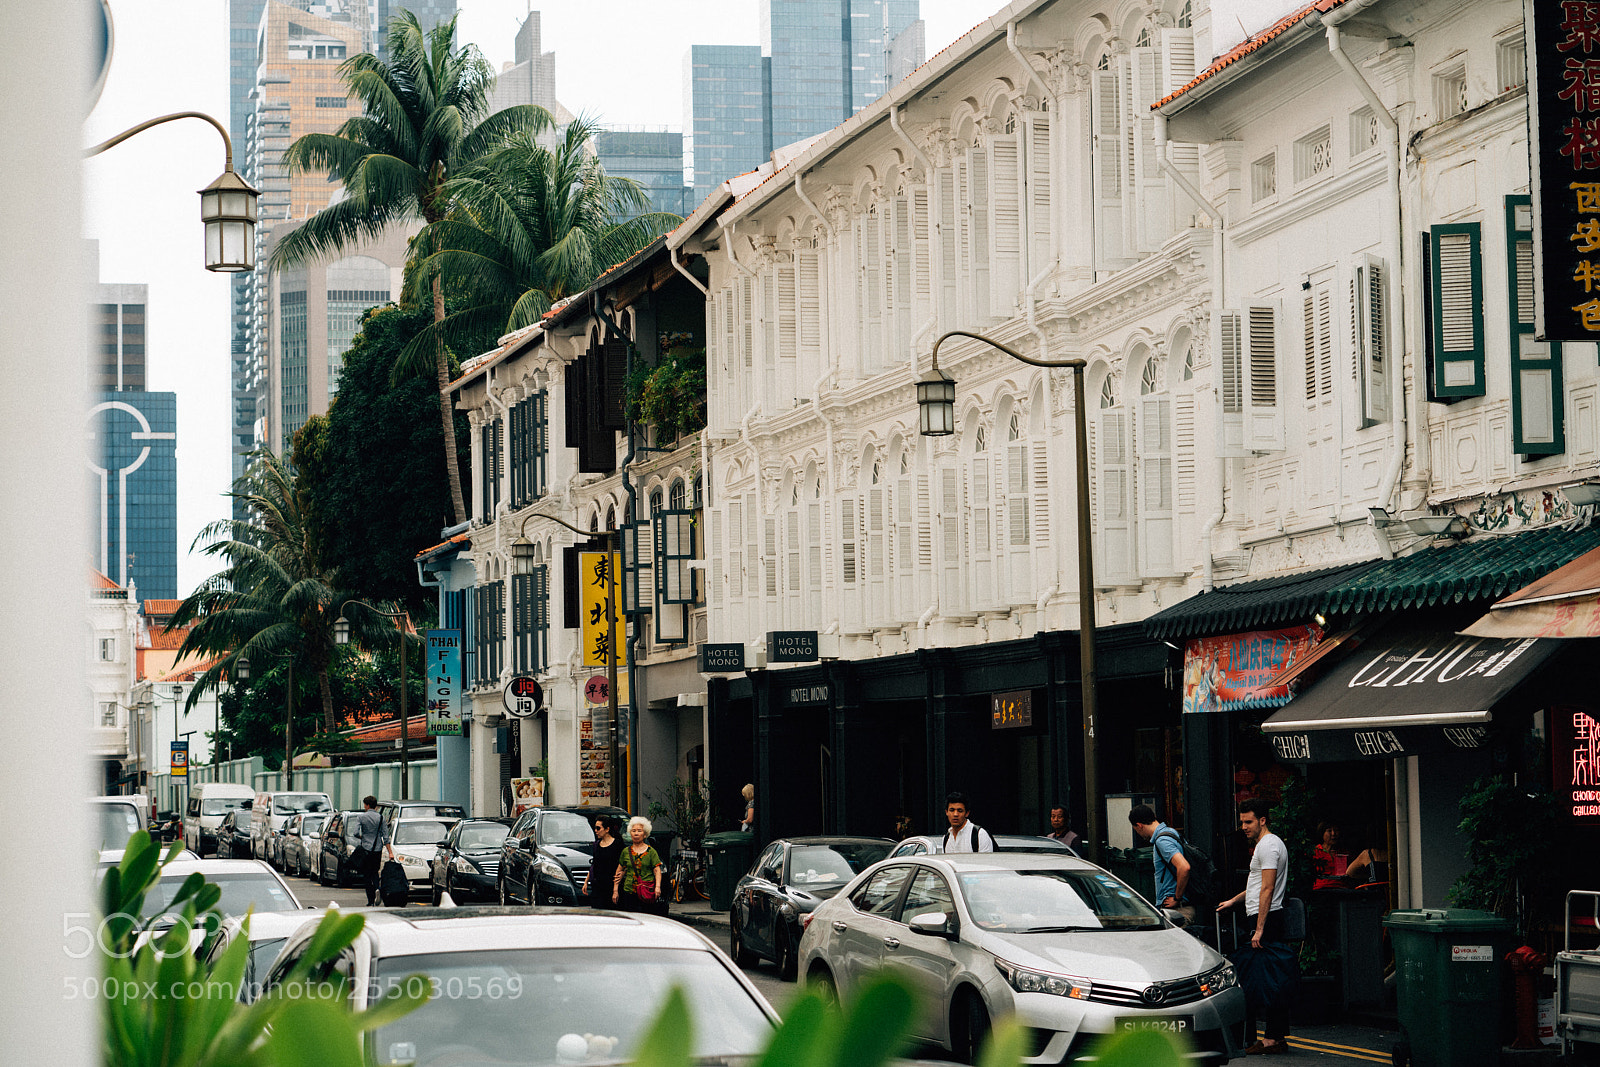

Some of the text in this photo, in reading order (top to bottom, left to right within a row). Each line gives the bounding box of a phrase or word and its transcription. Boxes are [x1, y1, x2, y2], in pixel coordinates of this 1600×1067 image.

[590, 554, 621, 665] 東北菜
[429, 637, 459, 648] THAI
[778, 637, 813, 646] HOTEL
[707, 649, 740, 657] HOTEL
[779, 647, 813, 655] MONO
[708, 658, 740, 666] MONO
[436, 650, 452, 719] FINGER
[517, 678, 535, 694] jig
[1225, 675, 1248, 692] Magical
[790, 686, 829, 703] HOTEL MONO
[515, 698, 532, 713] jig
[430, 723, 459, 732] HOUSE
